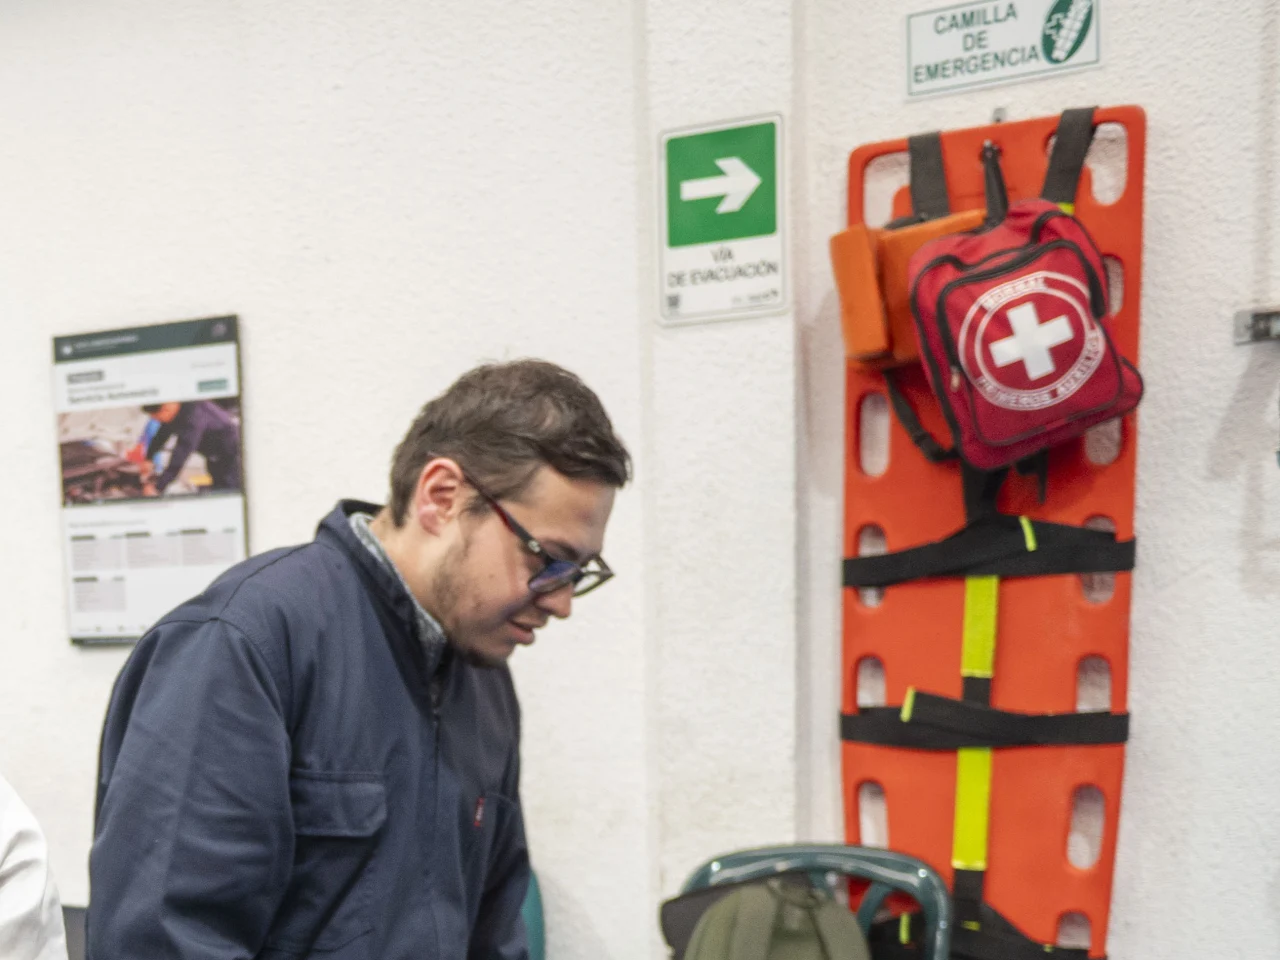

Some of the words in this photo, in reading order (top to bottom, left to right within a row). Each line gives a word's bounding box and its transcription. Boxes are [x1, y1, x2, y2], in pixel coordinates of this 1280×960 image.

[933, 3, 1017, 35] CAMILLA
[962, 30, 988, 52] DE
[913, 45, 1040, 84] EMERGENCIA
[667, 271, 686, 288] DE
